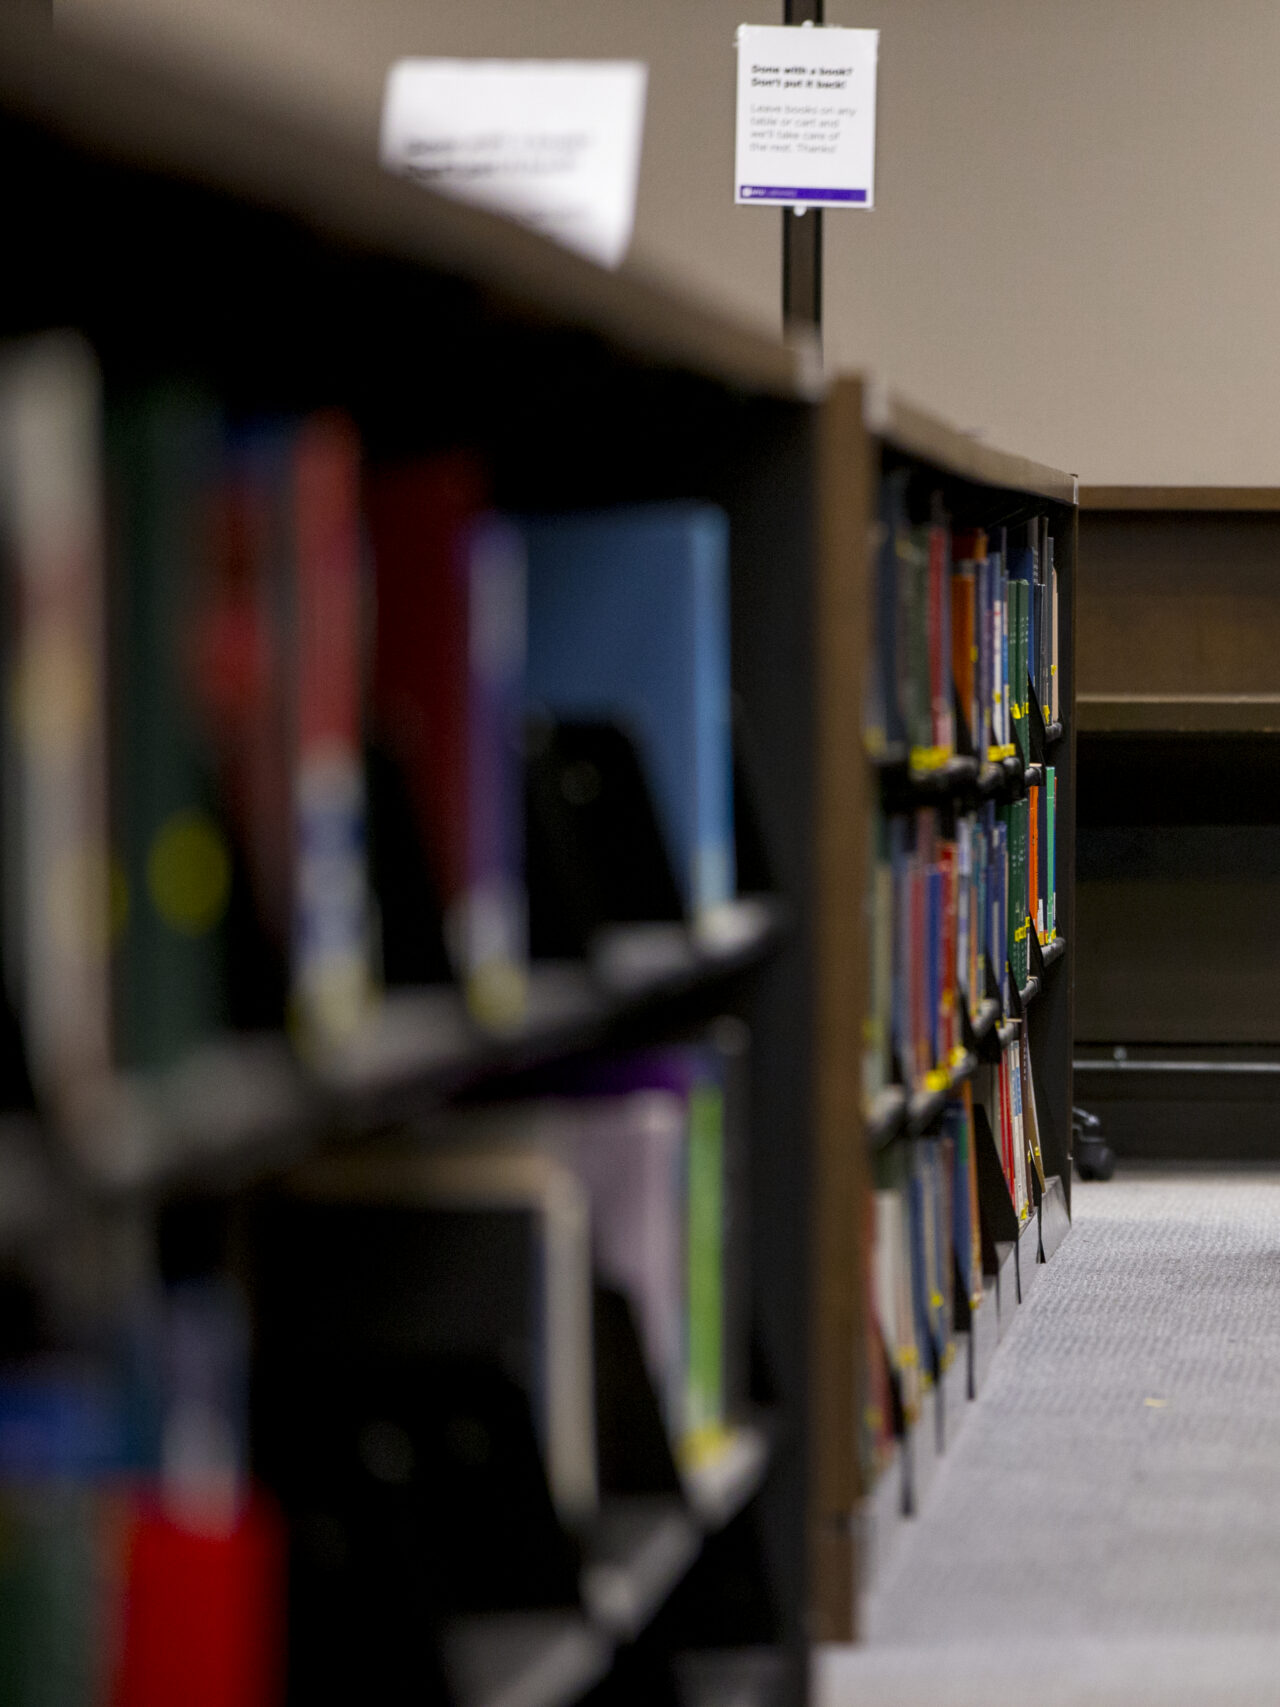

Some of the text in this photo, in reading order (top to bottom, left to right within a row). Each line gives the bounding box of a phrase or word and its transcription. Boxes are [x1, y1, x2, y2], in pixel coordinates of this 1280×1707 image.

[751, 65, 780, 74] Done
[784, 66, 806, 75] with
[819, 67, 853, 76] book?
[751, 78, 781, 87] Don't
[784, 80, 803, 89] put
[806, 80, 813, 88] it
[751, 104, 781, 113] Leave
[785, 105, 817, 114] books
[838, 108, 856, 117] any
[750, 117, 777, 126] table
[795, 119, 816, 127] cart
[819, 120, 840, 128] and
[776, 131, 799, 140] take
[828, 132, 840, 140] of
[750, 143, 766, 152] the
